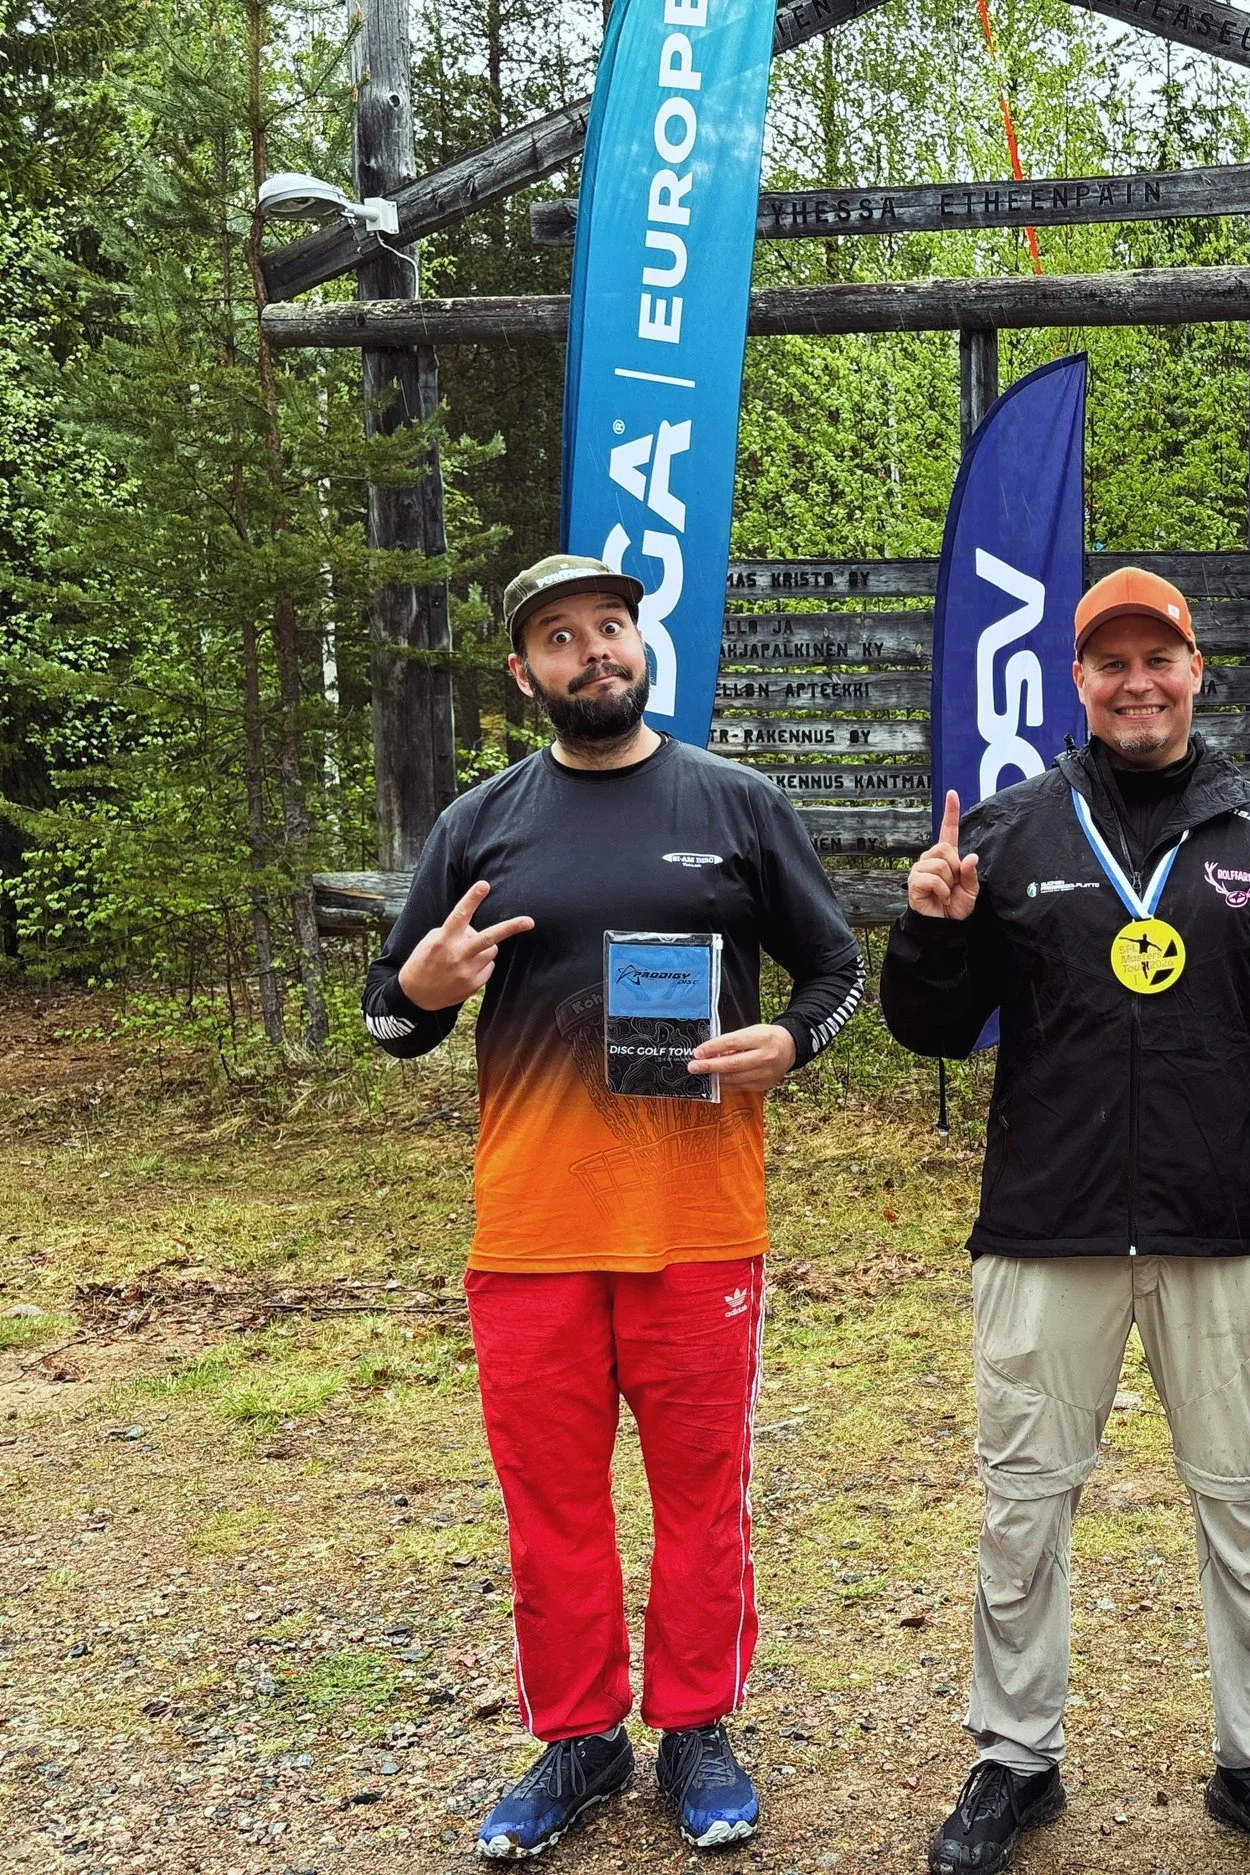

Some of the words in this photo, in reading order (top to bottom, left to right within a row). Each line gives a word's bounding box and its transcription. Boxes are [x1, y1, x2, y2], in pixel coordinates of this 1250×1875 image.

[638, 0, 707, 345] EUROPE
[770, 196, 897, 226] YHESSÄ
[772, 571, 834, 588] KRISTO
[849, 571, 871, 586] OY
[722, 619, 758, 635] LLO
[772, 619, 794, 634] JA
[862, 642, 884, 657] KY
[785, 682, 870, 697] APTEEKKI
[849, 729, 871, 743] OY
[854, 774, 931, 789] KANTMA
[633, 970, 692, 979] PRODIGY
[609, 1045, 635, 1055] DISC
[637, 1046, 667, 1056] GOLF
